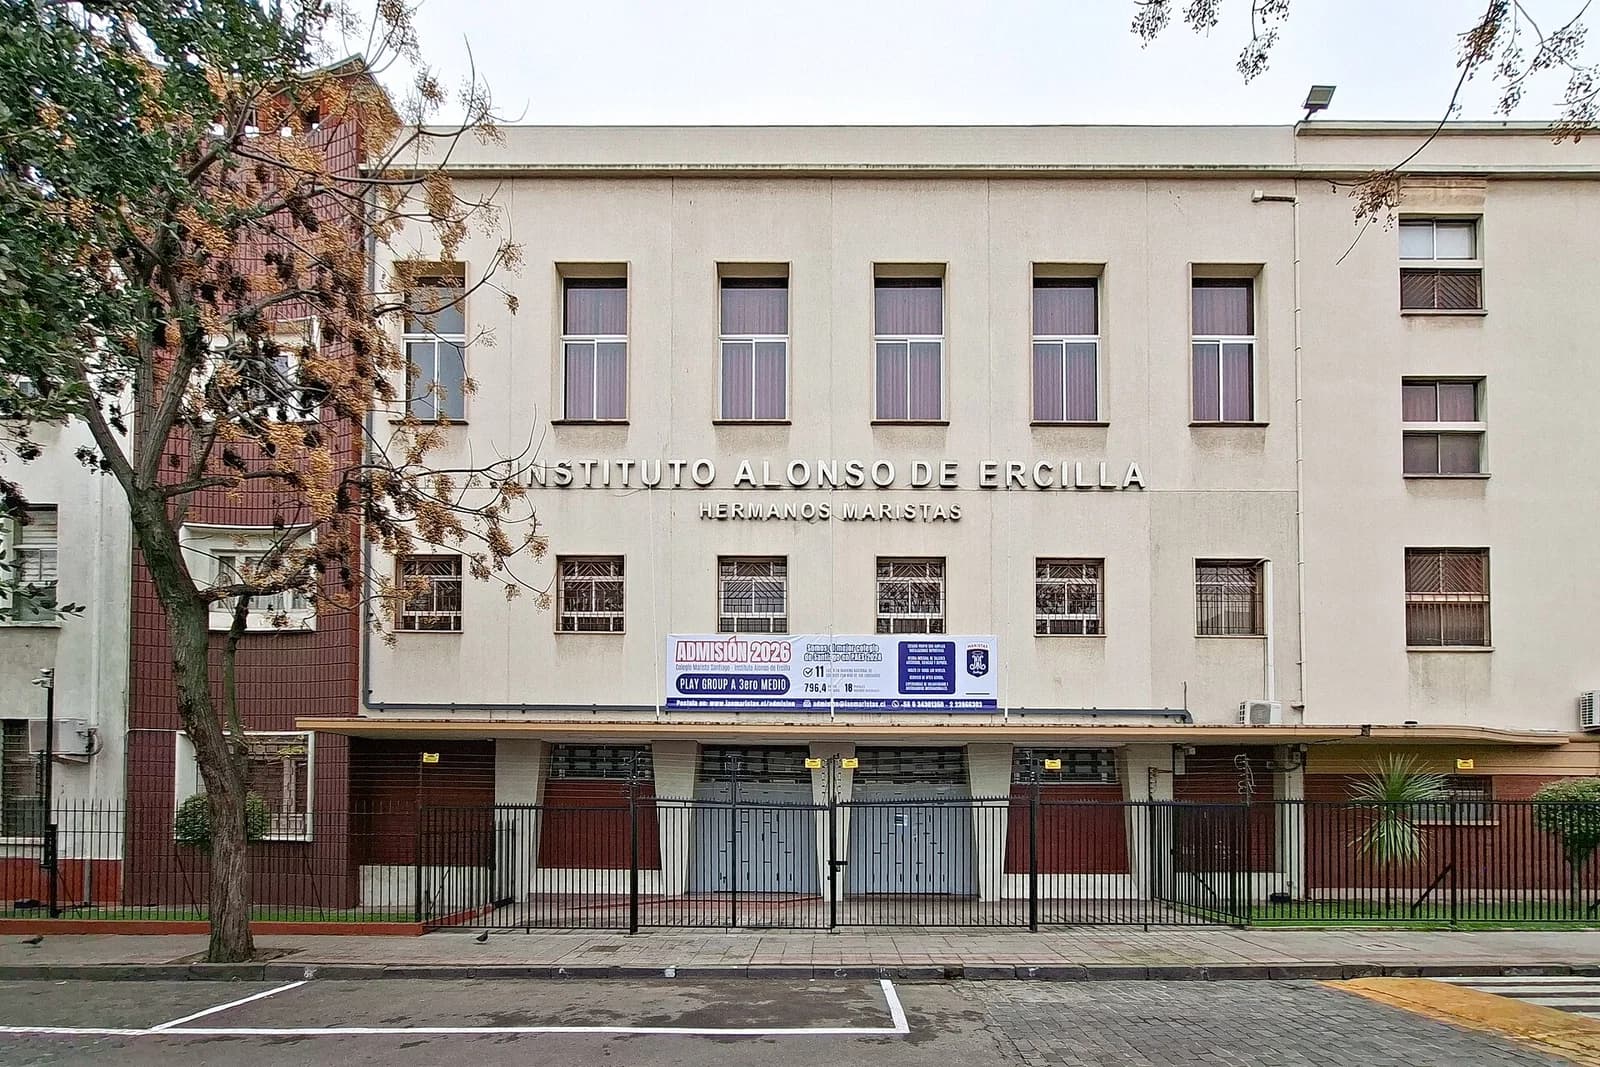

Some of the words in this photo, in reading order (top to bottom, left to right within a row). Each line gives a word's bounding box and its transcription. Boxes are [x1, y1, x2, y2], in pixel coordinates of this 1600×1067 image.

[733, 459, 897, 488] ALONSO
[910, 460, 958, 488] DE
[979, 461, 1146, 489] ERCILLA
[699, 502, 830, 520] HERMANOS
[842, 503, 962, 521] MARISTAS
[676, 636, 748, 662] ADMISIÓN
[750, 641, 792, 663] 2026
[807, 644, 828, 652] Somos
[815, 665, 824, 677] 11
[680, 678, 699, 690] PLAY
[701, 678, 728, 690] GROUP
[730, 679, 737, 690] A
[739, 679, 758, 690] 3ero
[761, 679, 786, 690] MEDIO
[804, 683, 827, 693] 796,4
[845, 683, 853, 693] 18
